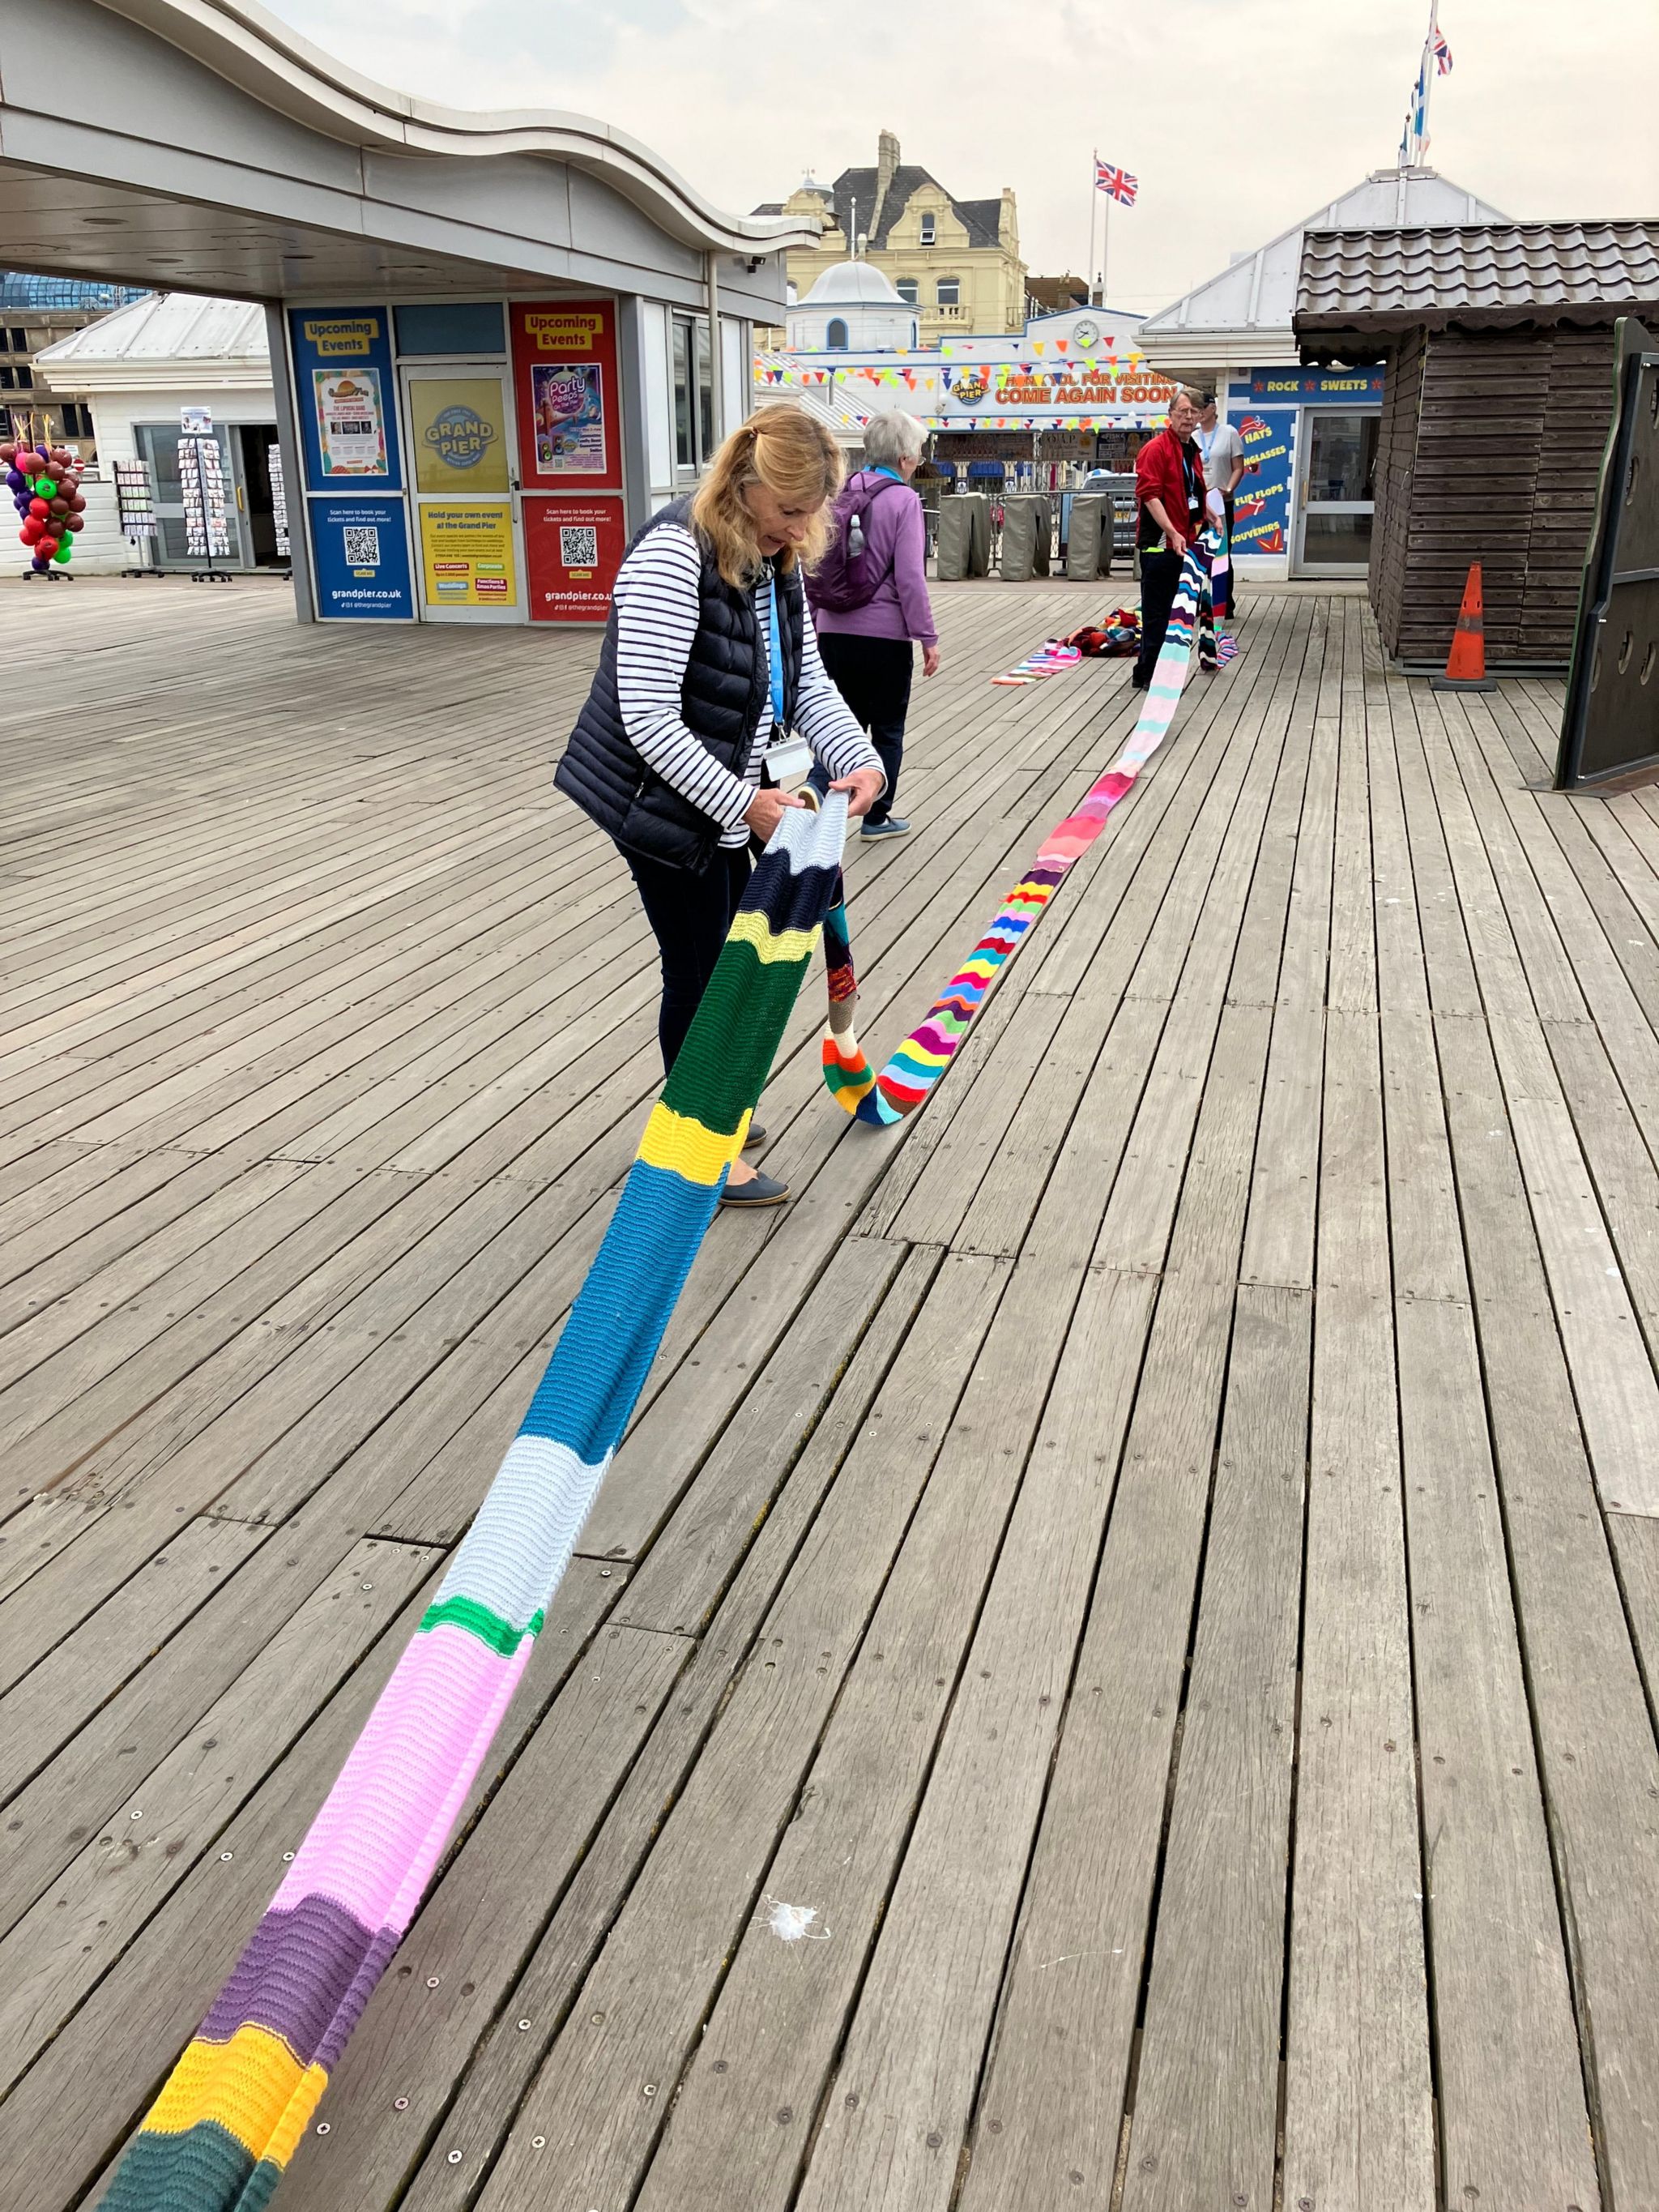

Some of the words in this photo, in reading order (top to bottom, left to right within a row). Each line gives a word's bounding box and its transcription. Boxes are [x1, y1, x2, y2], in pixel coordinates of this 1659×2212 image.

[309, 321, 372, 337] Upcoming
[531, 315, 596, 331] Upcoming
[322, 339, 363, 351] Events
[542, 334, 585, 345] Events
[550, 376, 586, 397] Party
[1081, 373, 1112, 386] FOR
[1267, 381, 1299, 391] ROCK
[1320, 380, 1367, 391] SWEETS
[552, 391, 578, 404] Peeps
[959, 388, 982, 399] PIER
[995, 387, 1051, 405] COME
[1053, 387, 1117, 404] AGAIN
[1120, 386, 1178, 404] SOON
[425, 421, 493, 442] GRAND
[1244, 426, 1273, 444] HATS
[440, 437, 481, 455] PIER
[1243, 445, 1286, 467] NGLASSES
[1235, 493, 1254, 506] FLIP
[1255, 484, 1283, 499] FLOPS
[446, 512, 463, 520] your
[1230, 521, 1280, 544] SOUVENIRS
[331, 589, 402, 600] grandpier.co.uk
[544, 591, 612, 601] grandpier.co.u
